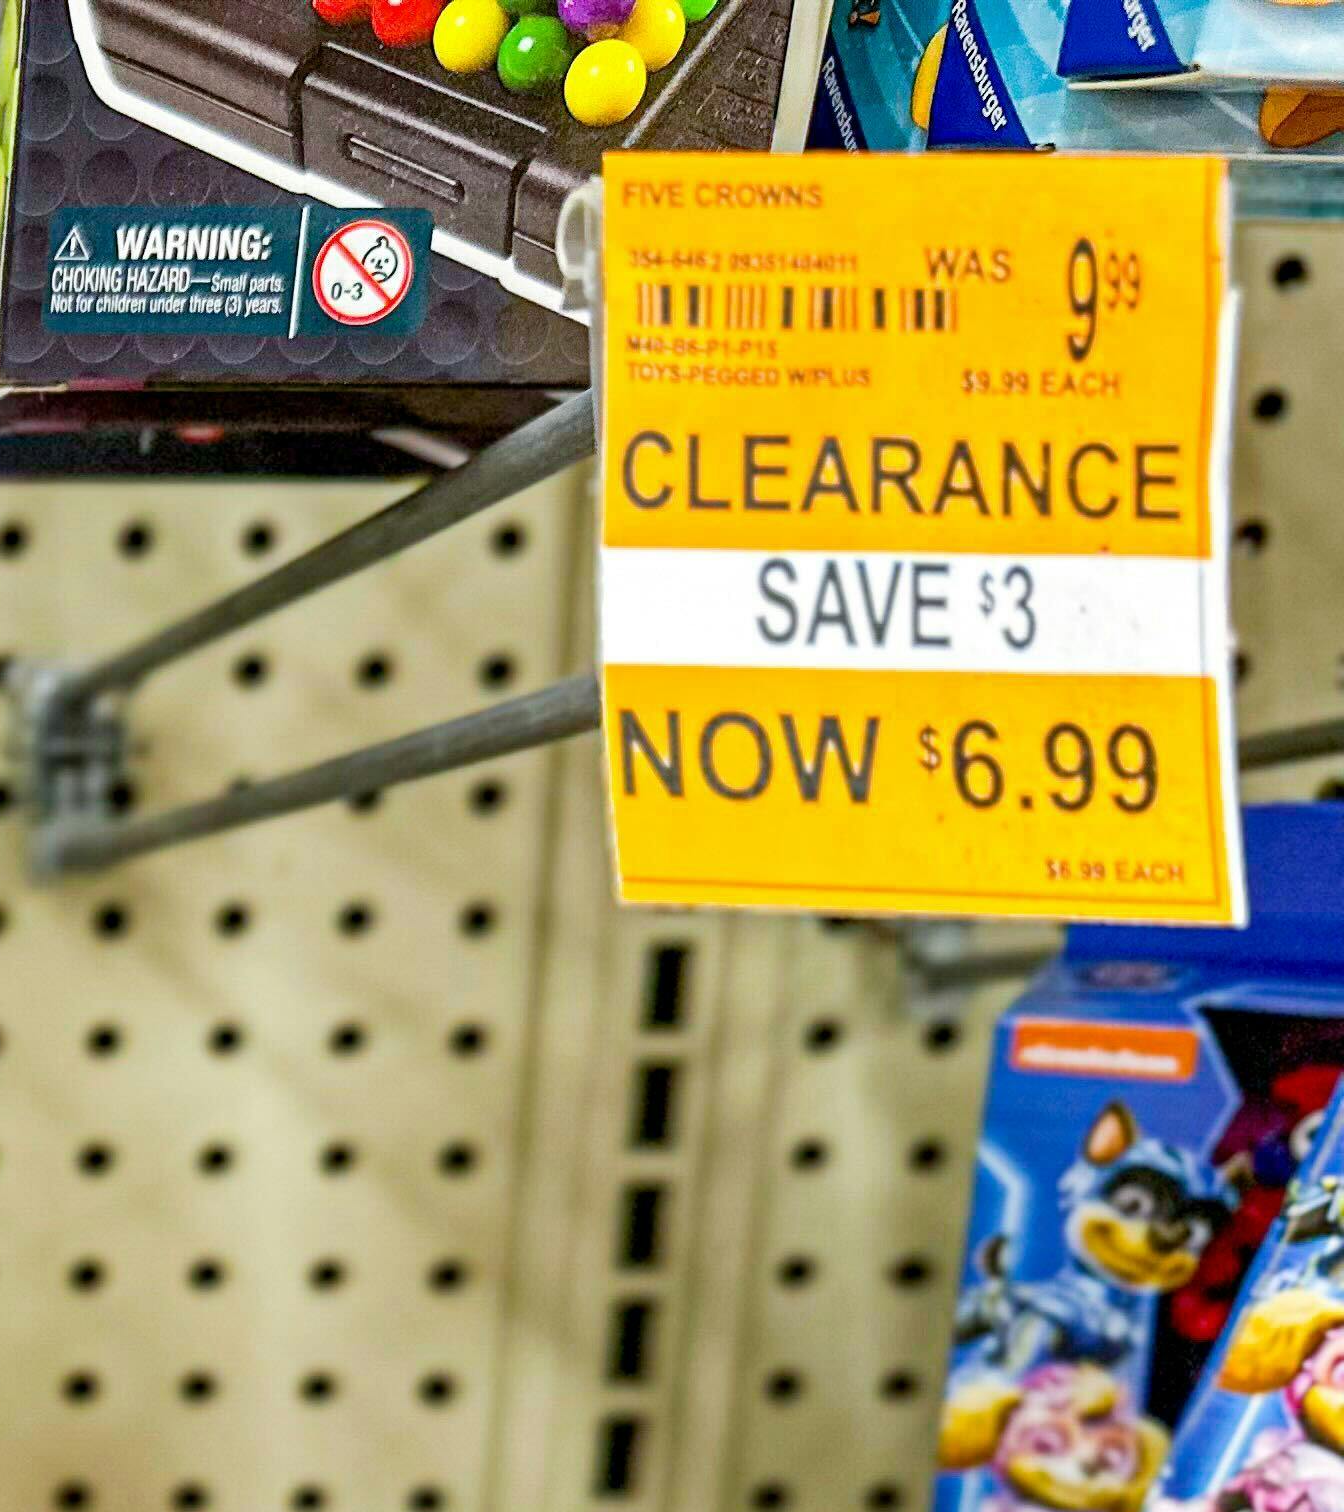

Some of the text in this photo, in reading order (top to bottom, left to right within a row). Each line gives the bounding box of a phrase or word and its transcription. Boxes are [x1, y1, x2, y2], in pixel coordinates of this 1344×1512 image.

[951, 0, 1008, 132] Ravensburger
[822, 55, 861, 154] Ravensbu
[621, 183, 825, 209] FIVE CROWNS
[115, 226, 273, 262] WARNING:
[50, 266, 123, 293] CHOKING
[925, 247, 1012, 285] WAS
[50, 294, 283, 318] Not for children under three (3) years.
[329, 280, 364, 302] 0-3
[627, 360, 781, 387] TOYS-PEGGED
[961, 369, 1122, 397] $9.99 EACH
[621, 430, 1182, 521] CLEARANCE
[754, 556, 1038, 652] SAVE $3
[618, 707, 1160, 815] NOW $6.99
[1113, 860, 1186, 884] EACH
